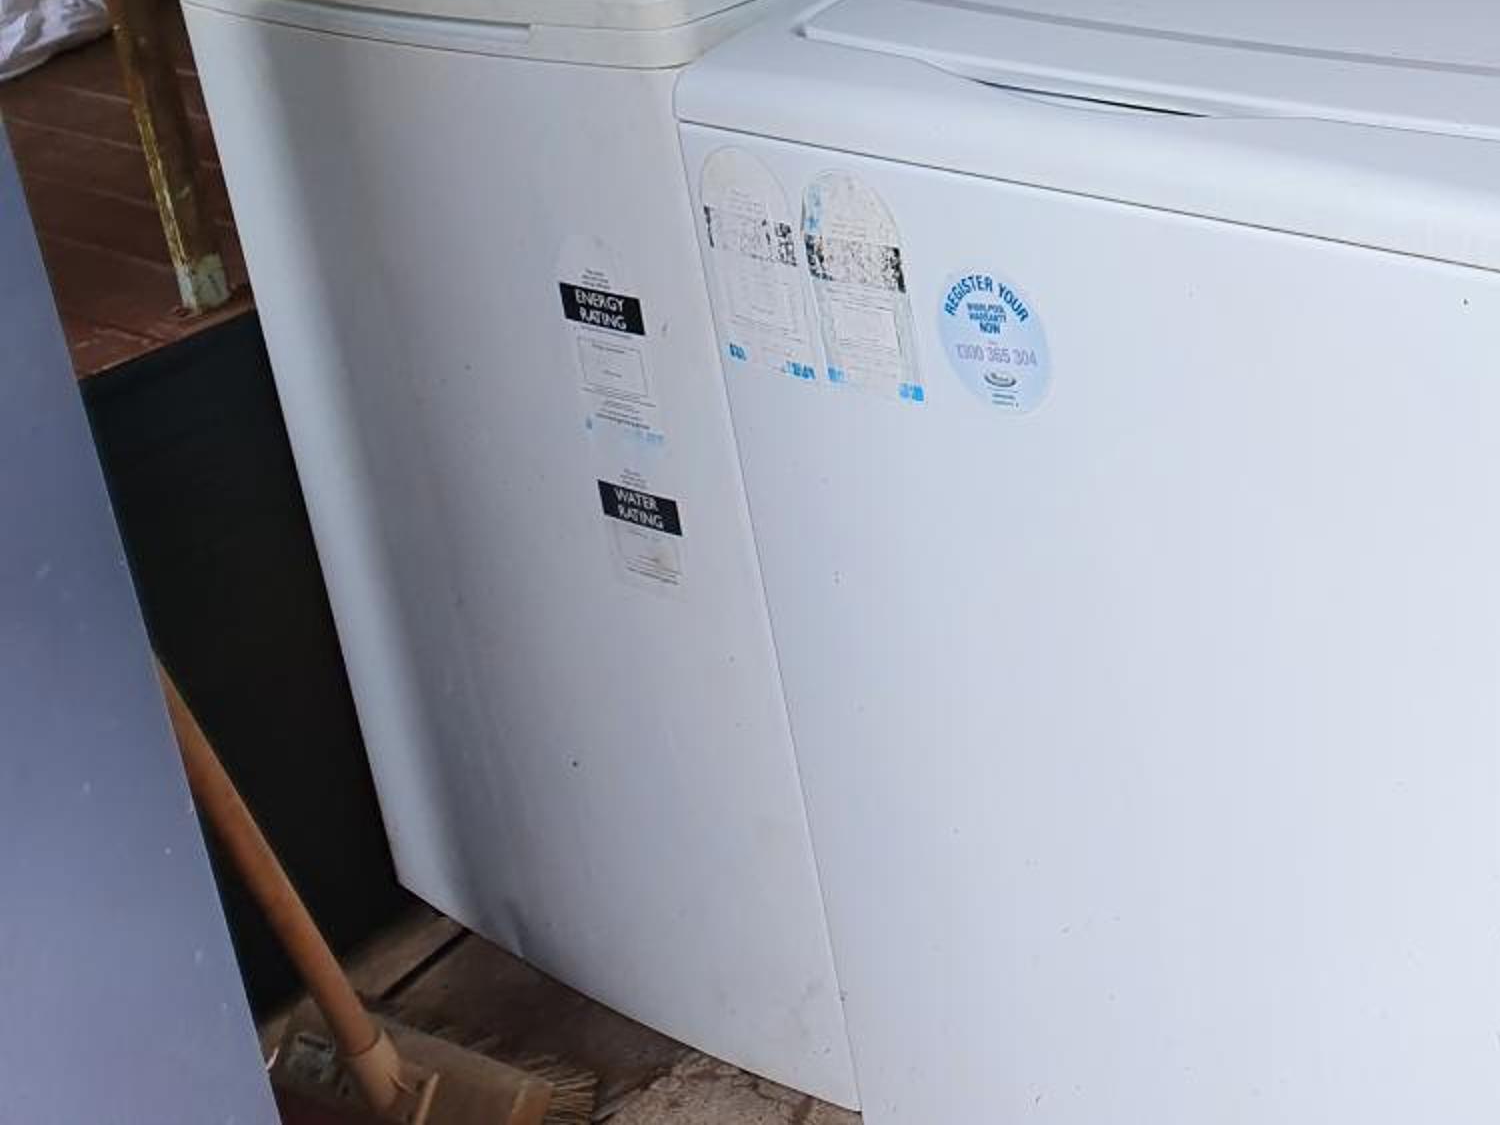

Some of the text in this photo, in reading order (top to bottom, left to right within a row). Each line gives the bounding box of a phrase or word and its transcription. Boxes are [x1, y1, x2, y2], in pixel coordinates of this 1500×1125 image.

[575, 288, 624, 312] ENERGY
[944, 274, 1029, 322] REGISTER YOUR
[579, 306, 627, 330] RATING
[979, 322, 1001, 334] NOW
[955, 343, 985, 362] 1300
[1012, 348, 1038, 366] 304
[614, 487, 659, 512] WATER
[618, 503, 664, 529] RATING
